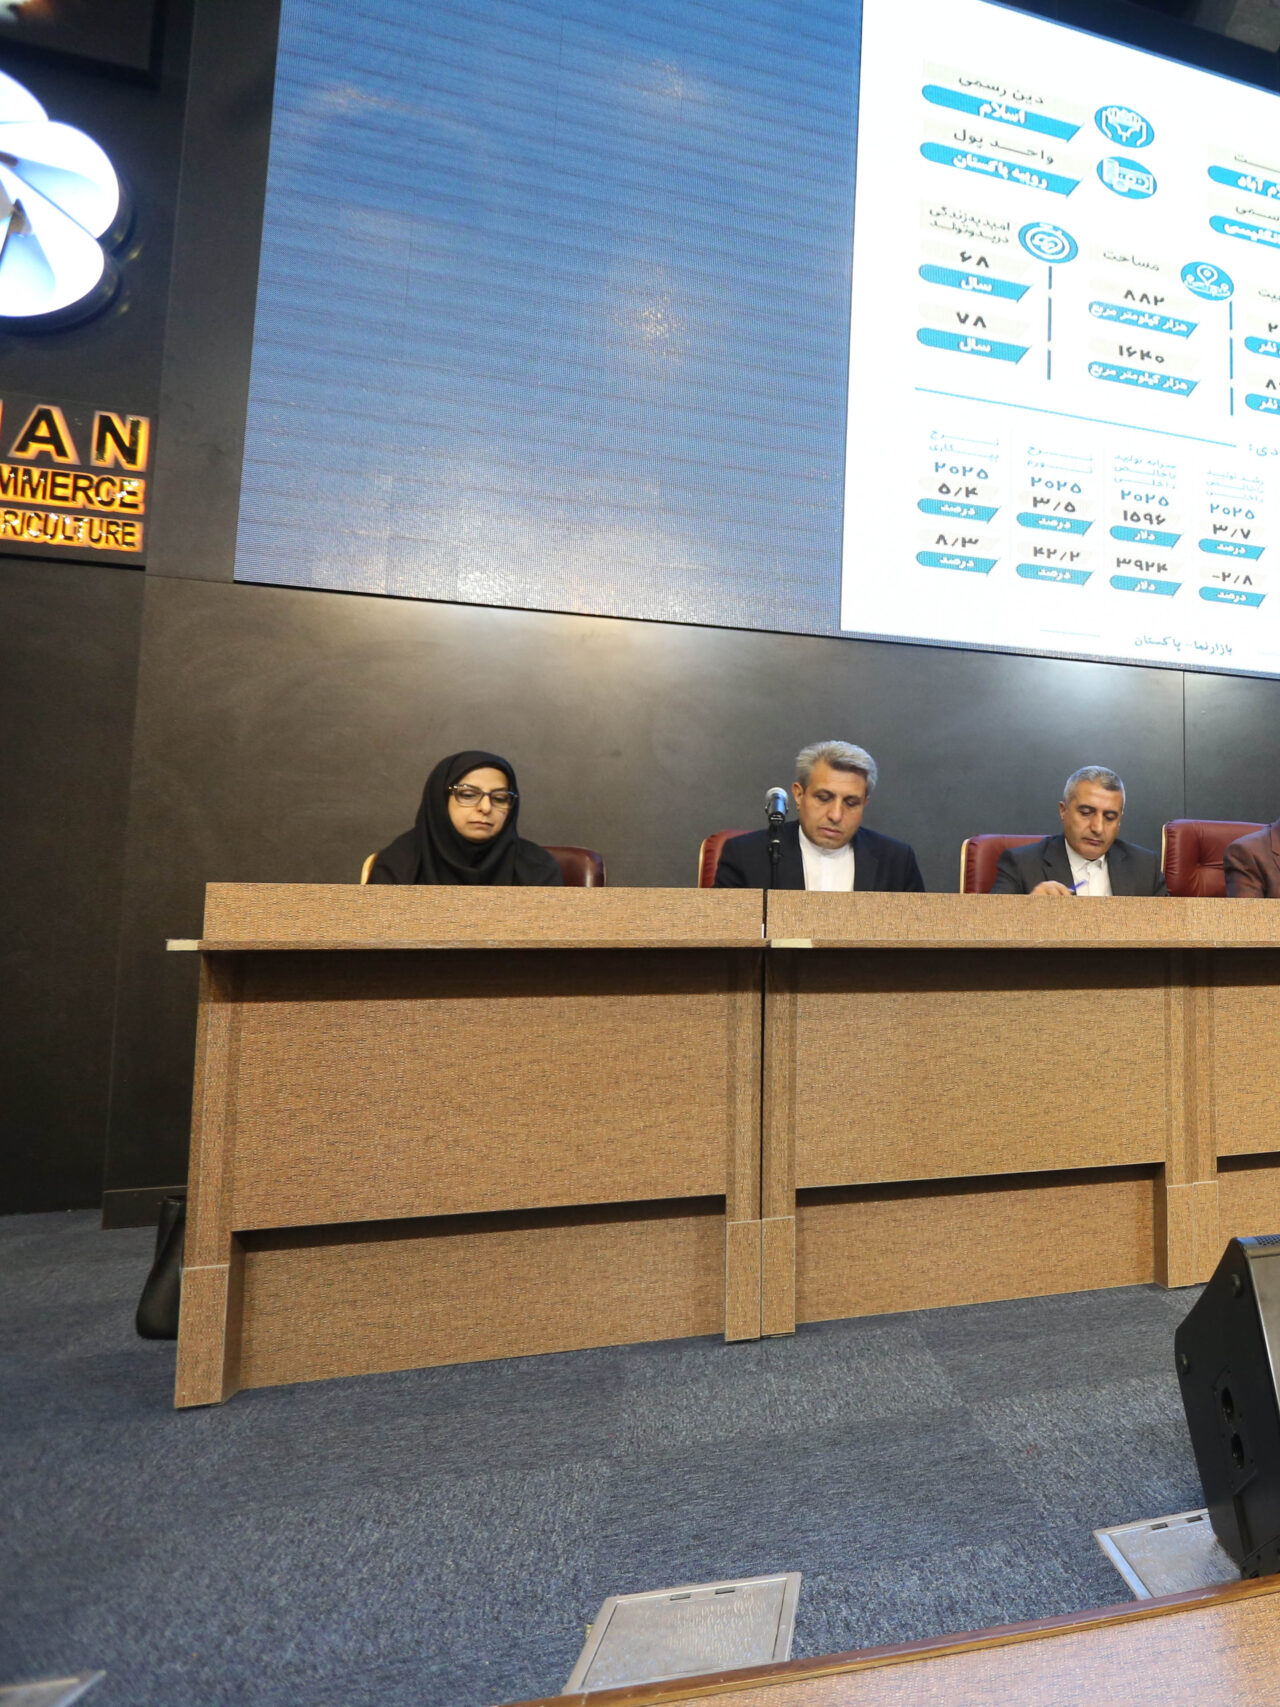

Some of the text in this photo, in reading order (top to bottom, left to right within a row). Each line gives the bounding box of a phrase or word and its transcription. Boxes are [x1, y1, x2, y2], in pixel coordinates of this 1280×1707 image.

[958, 74, 1045, 105] دین رسمی
[978, 101, 1026, 124] اسلام
[954, 129, 1054, 165] واحد پول
[953, 150, 1048, 190] روپیه پاکستان
[1237, 175, 1264, 193] آباد
[960, 250, 989, 268] ۶۸
[1103, 251, 1160, 271] مساحت
[961, 276, 993, 292] سال
[1123, 289, 1165, 306] ۸۸۲
[956, 311, 987, 329] ۷۸
[1119, 311, 1161, 327] کیلومتر
[1162, 318, 1189, 332] هزار
[959, 337, 991, 353] سال
[1258, 341, 1277, 353] نفر
[1118, 345, 1165, 363] ۱۶۴۰
[1119, 370, 1161, 385] کیلومتر
[1163, 377, 1189, 391] هزار
[1258, 398, 1278, 410] نفر
[0, 402, 150, 472] AN
[934, 461, 989, 480] ۲۰۲۵
[938, 483, 978, 498] ۵/۴
[1031, 476, 1082, 494] ۲۰۲۵
[1032, 496, 1076, 513] ۳/۵
[1120, 490, 1169, 507] ۲۰۲۵
[940, 504, 977, 517] درصد
[1123, 510, 1166, 525] ۱۵۹۶
[1210, 503, 1255, 520] ۲۰۲۵
[1037, 517, 1073, 530] درصد
[1213, 523, 1251, 539] ۳/۷
[936, 534, 979, 548] ۸/۳
[1133, 530, 1157, 541] دلار
[1216, 543, 1247, 555] درصد
[938, 556, 975, 568] درصد
[1116, 557, 1168, 573] ۳۹۲۴
[1037, 568, 1073, 581] درصد
[1133, 580, 1157, 592] دلار
[1216, 591, 1247, 603] درصد
[1134, 635, 1182, 652] پاکستان
